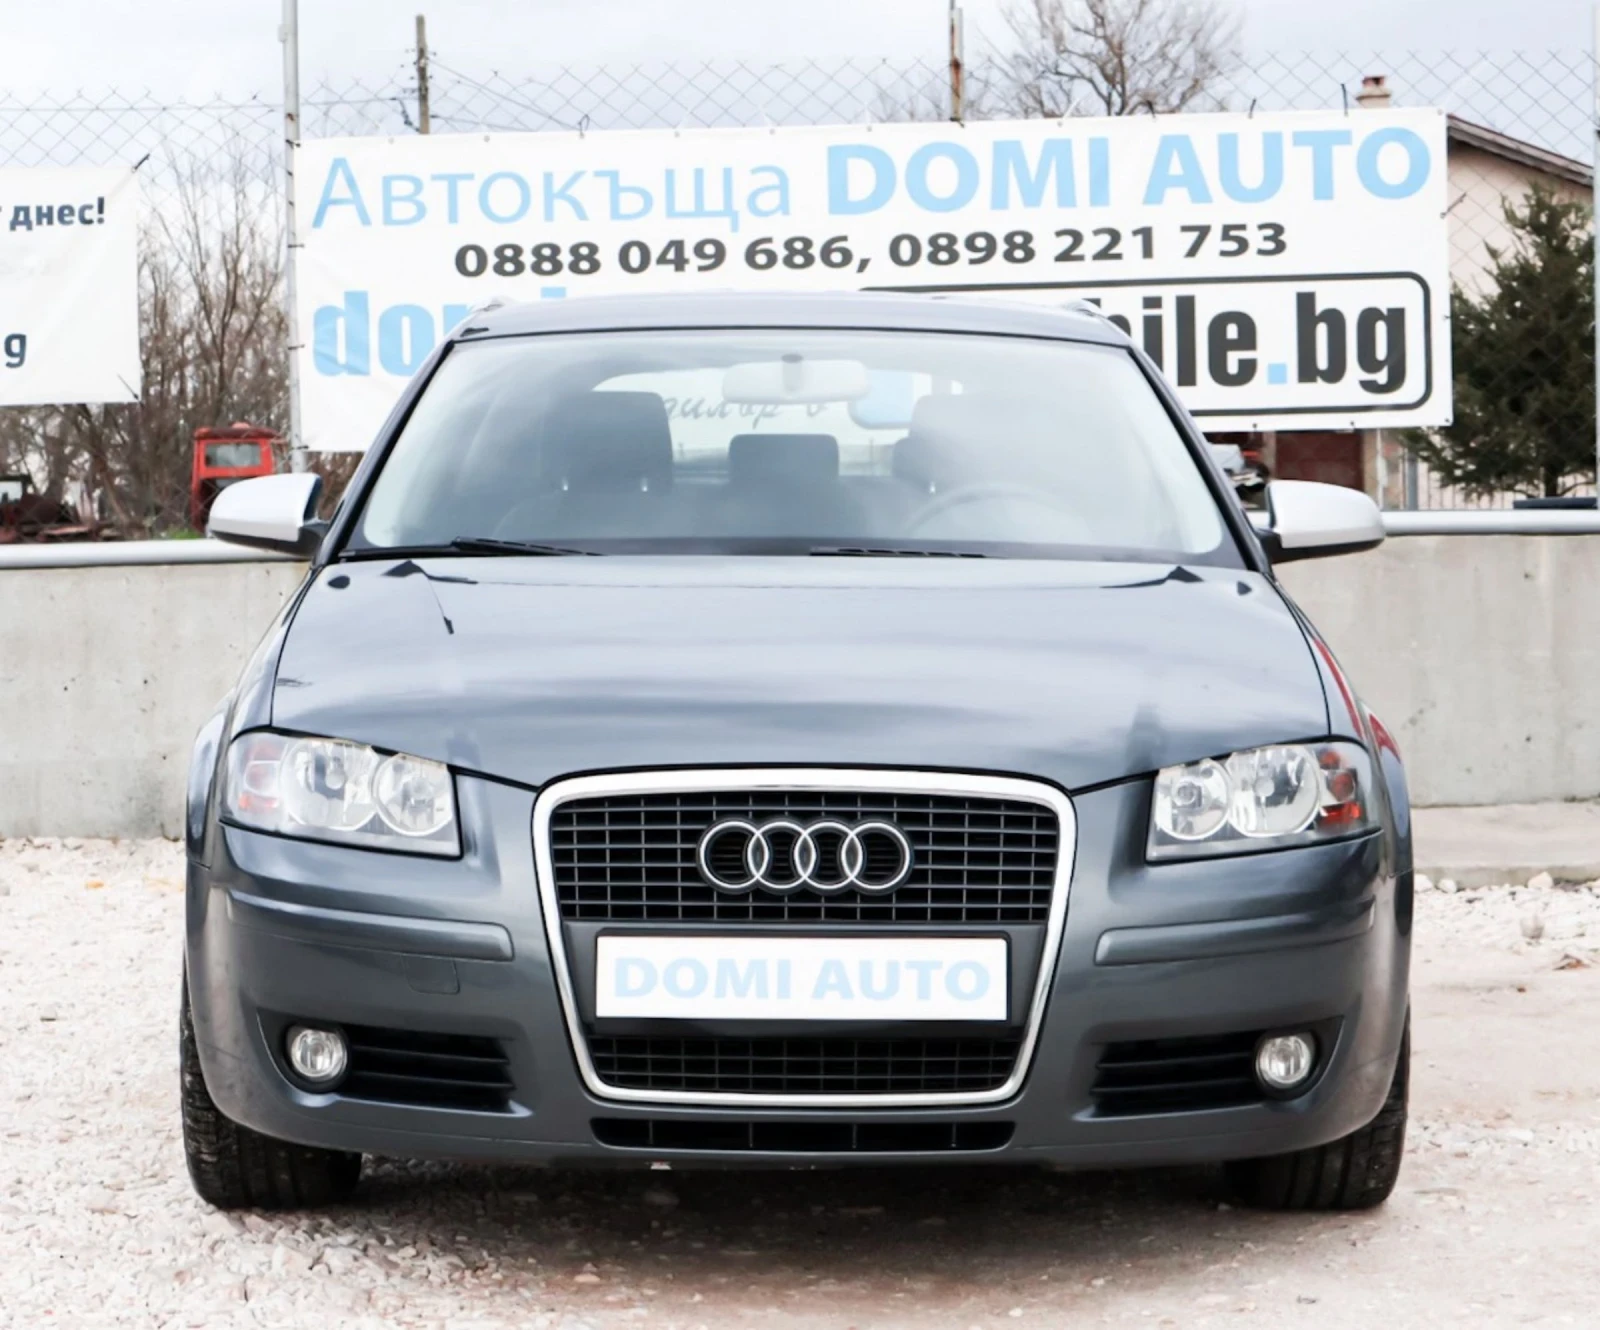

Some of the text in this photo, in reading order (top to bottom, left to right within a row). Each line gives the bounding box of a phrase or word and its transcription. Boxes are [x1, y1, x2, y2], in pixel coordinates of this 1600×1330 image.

[312, 127, 1432, 232] Автокъща DOMI AUTO
[9, 196, 105, 232] днес!
[454, 222, 1288, 278] 0888 049 686, 0898 221 753
[614, 957, 991, 1002] DOMI AUTO
